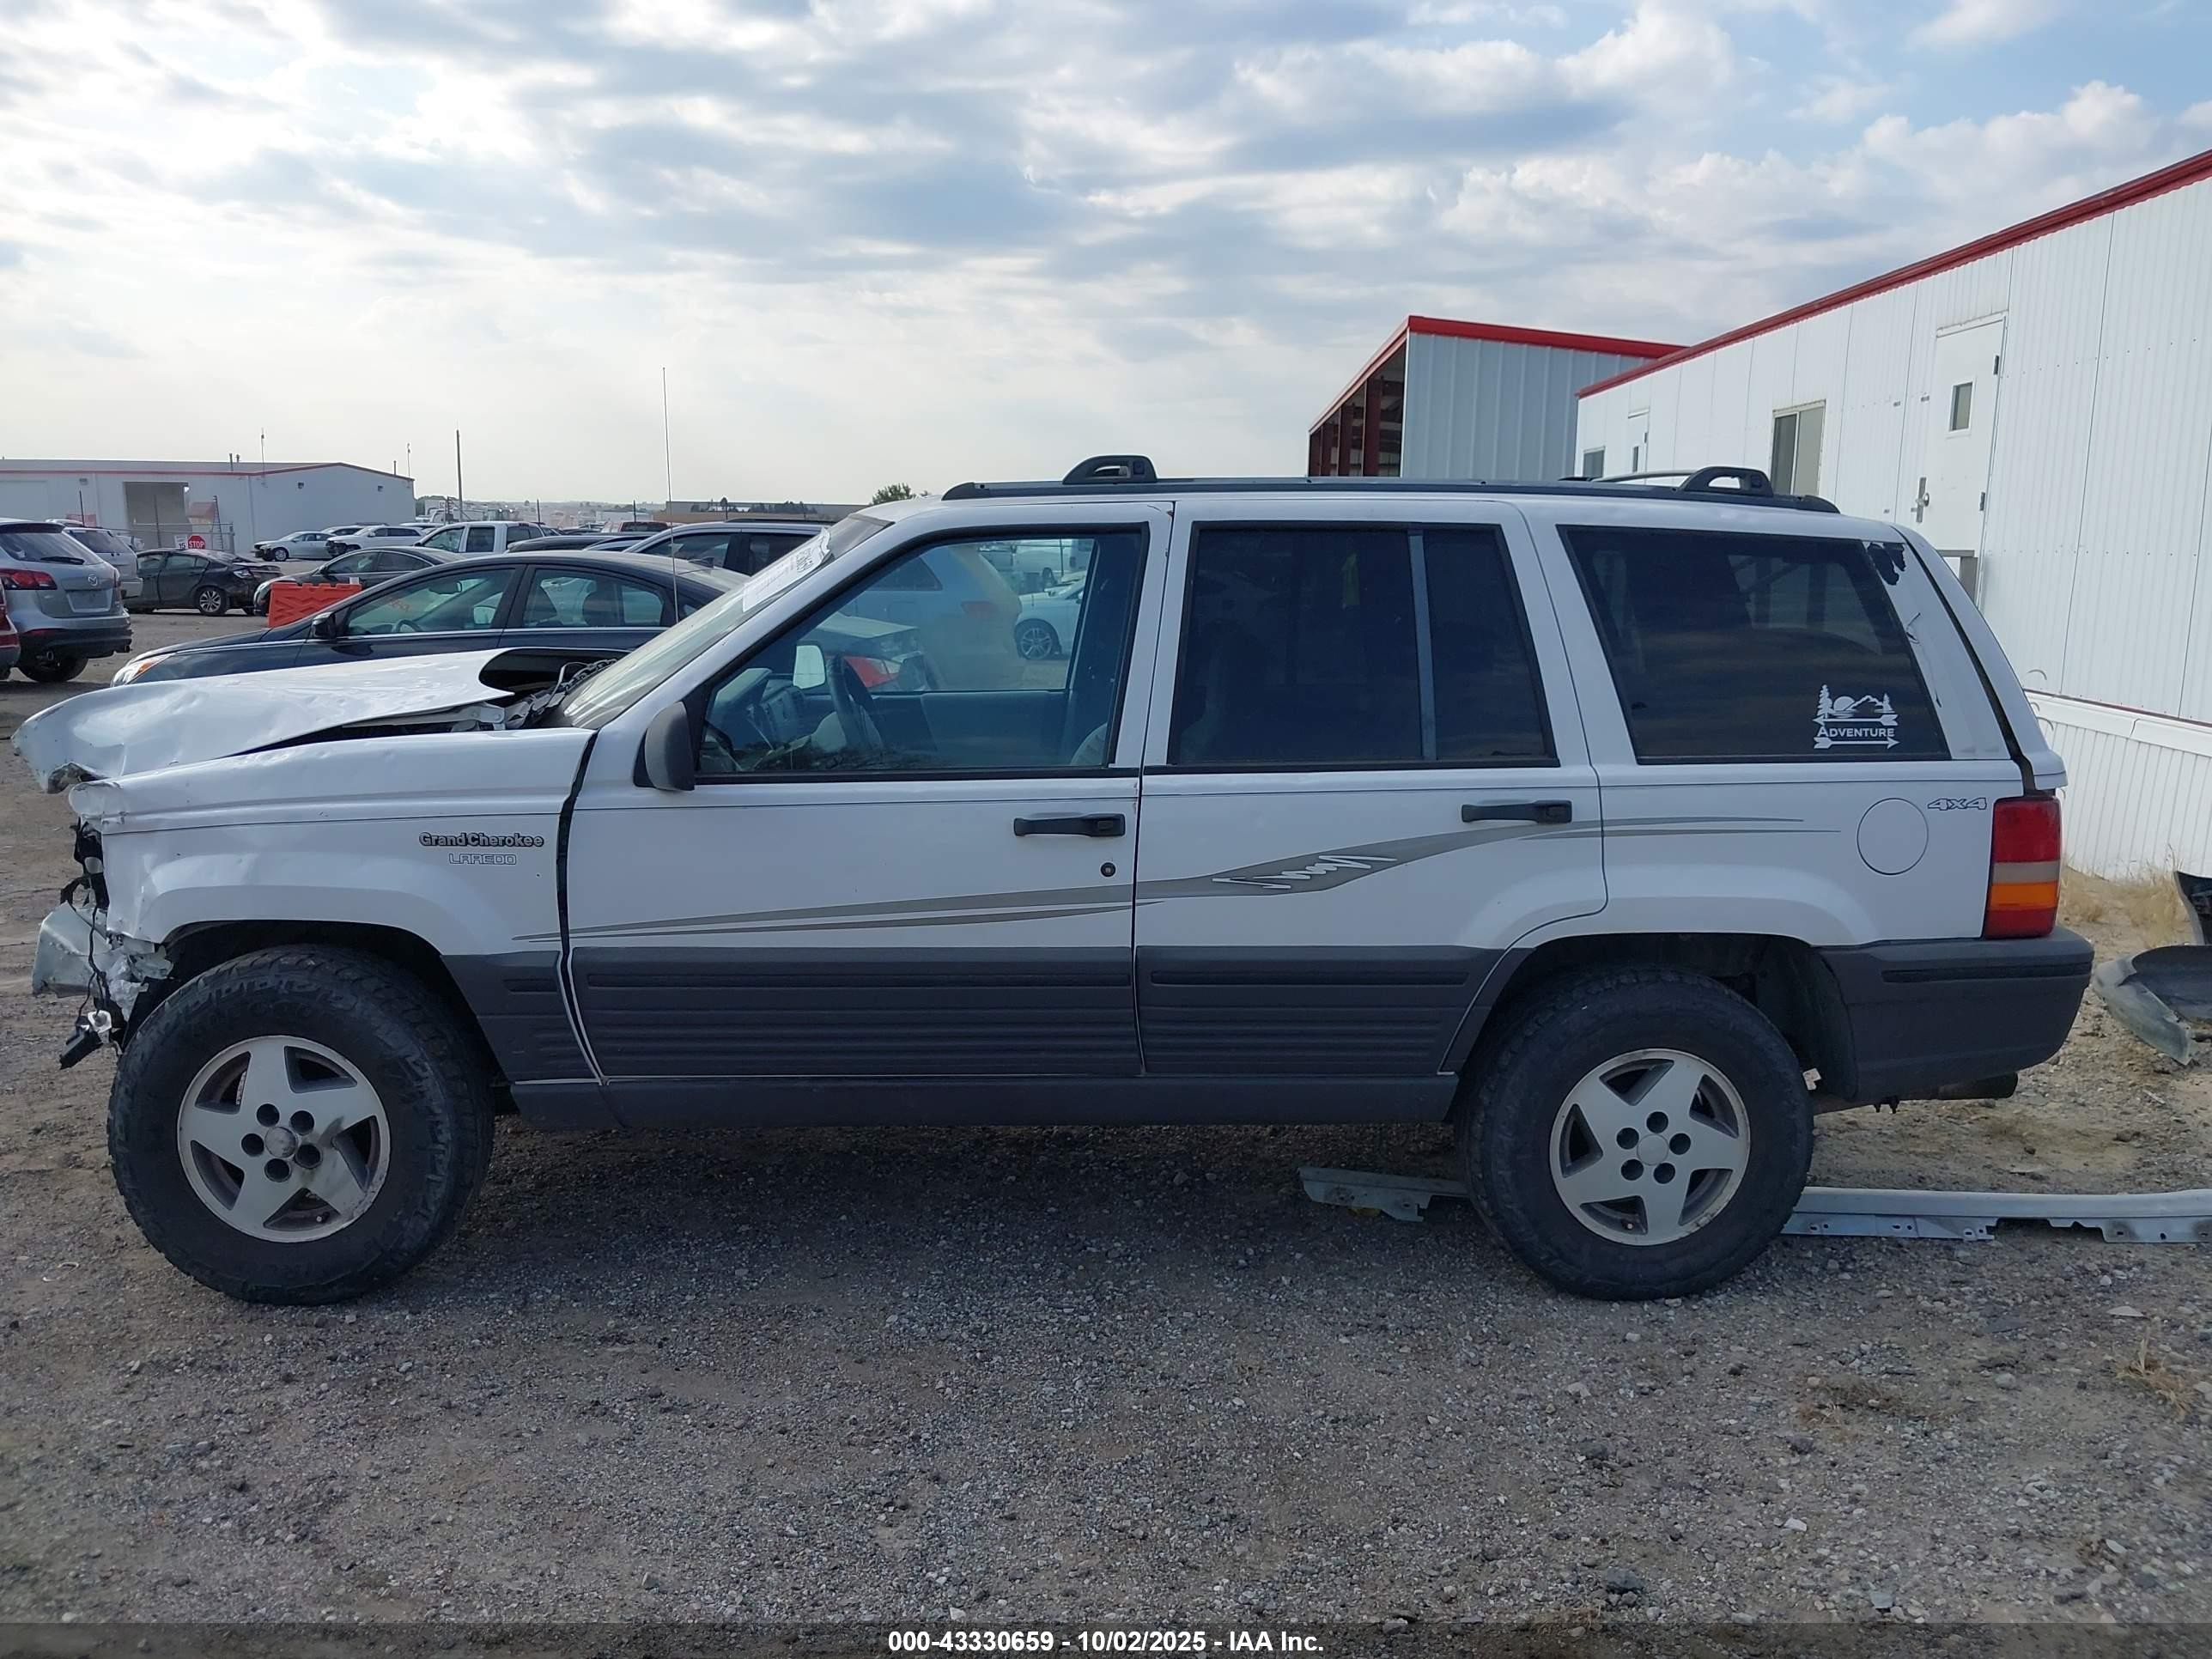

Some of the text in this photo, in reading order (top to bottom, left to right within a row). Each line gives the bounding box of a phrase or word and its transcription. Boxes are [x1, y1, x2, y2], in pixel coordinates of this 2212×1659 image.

[188, 540, 205, 549] STOP
[1816, 726, 1895, 738] ADVENTURE
[448, 853, 517, 866] LAREDO
